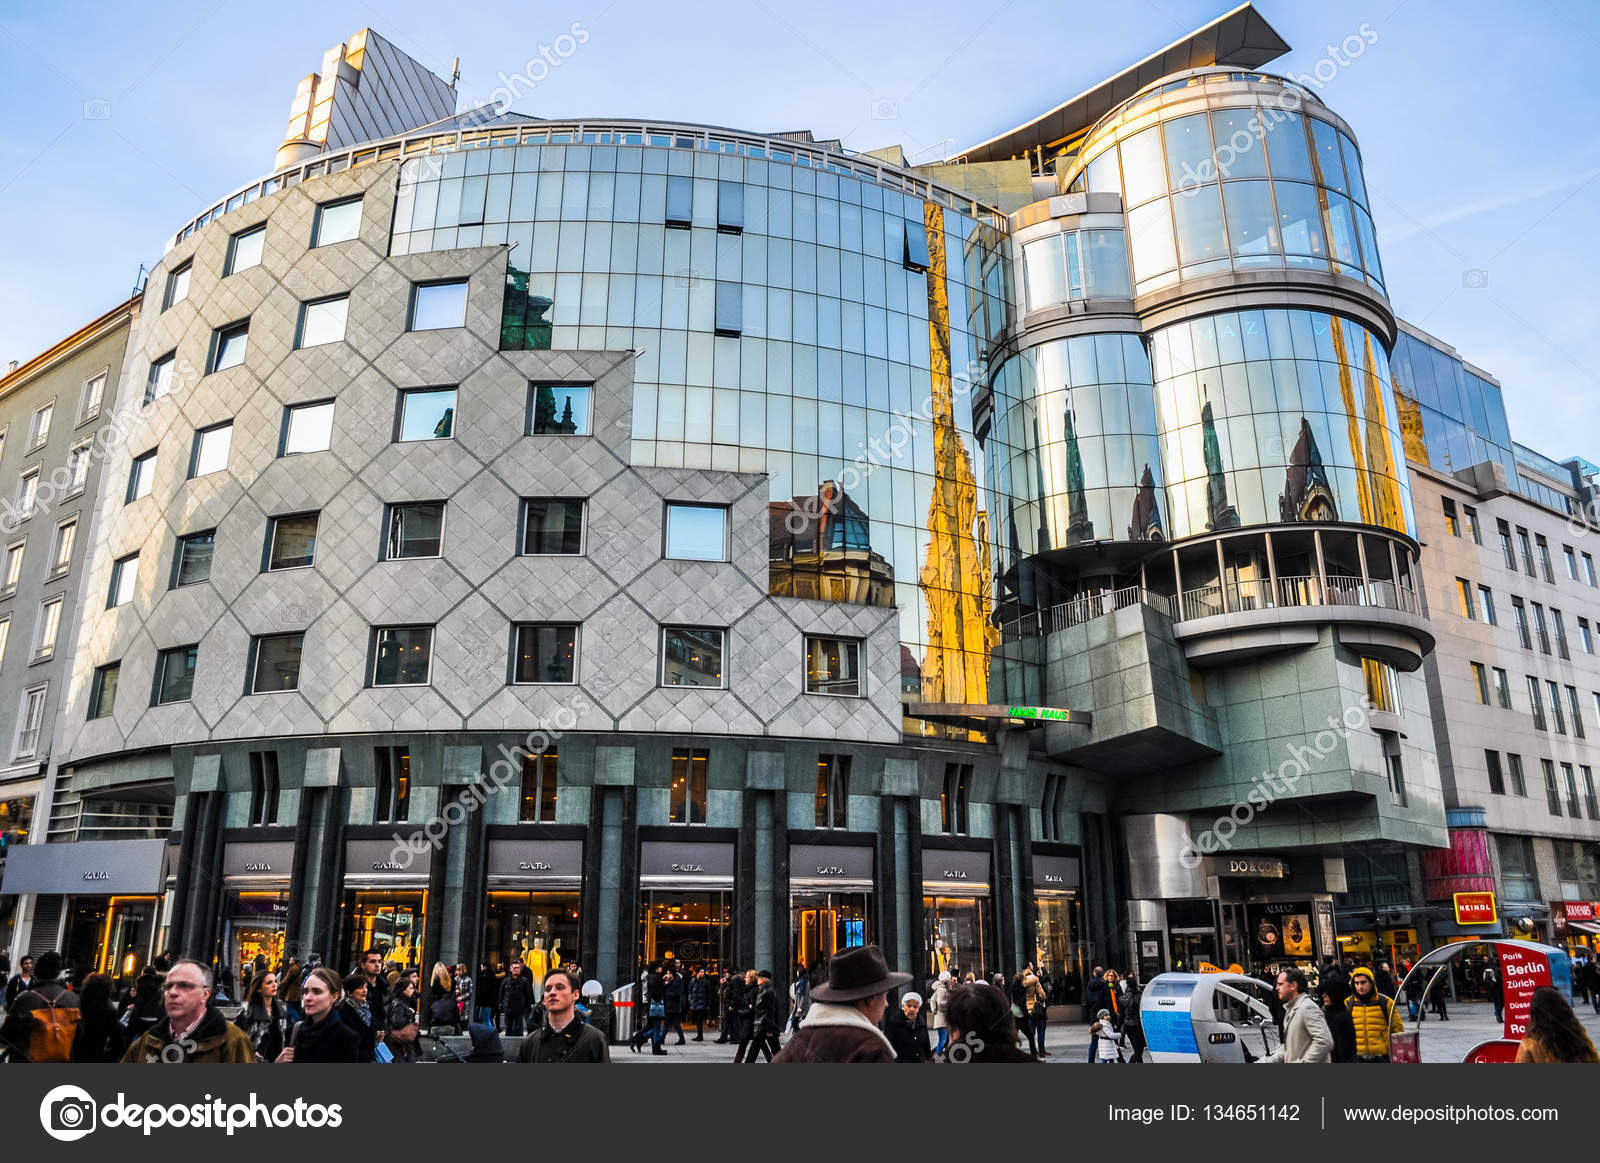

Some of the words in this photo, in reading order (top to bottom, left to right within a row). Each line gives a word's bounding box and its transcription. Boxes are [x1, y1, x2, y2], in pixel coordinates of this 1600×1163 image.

[1008, 706, 1037, 719] HAAS
[1040, 708, 1067, 720] HAUS
[245, 863, 271, 871] ZARA
[374, 861, 404, 870] ZARA
[519, 861, 551, 871] ZARA
[671, 863, 704, 872] ZARA
[816, 865, 844, 875] ZARA
[1230, 860, 1248, 872] DO
[1249, 863, 1257, 872] &
[83, 871, 110, 880] ZARA
[943, 869, 967, 879] ZARA
[1045, 873, 1063, 883] ZARA
[1459, 903, 1491, 912] HEINDL
[1502, 952, 1523, 961] Paris
[1506, 961, 1545, 976] Berlin
[1506, 978, 1535, 989] Zürich
